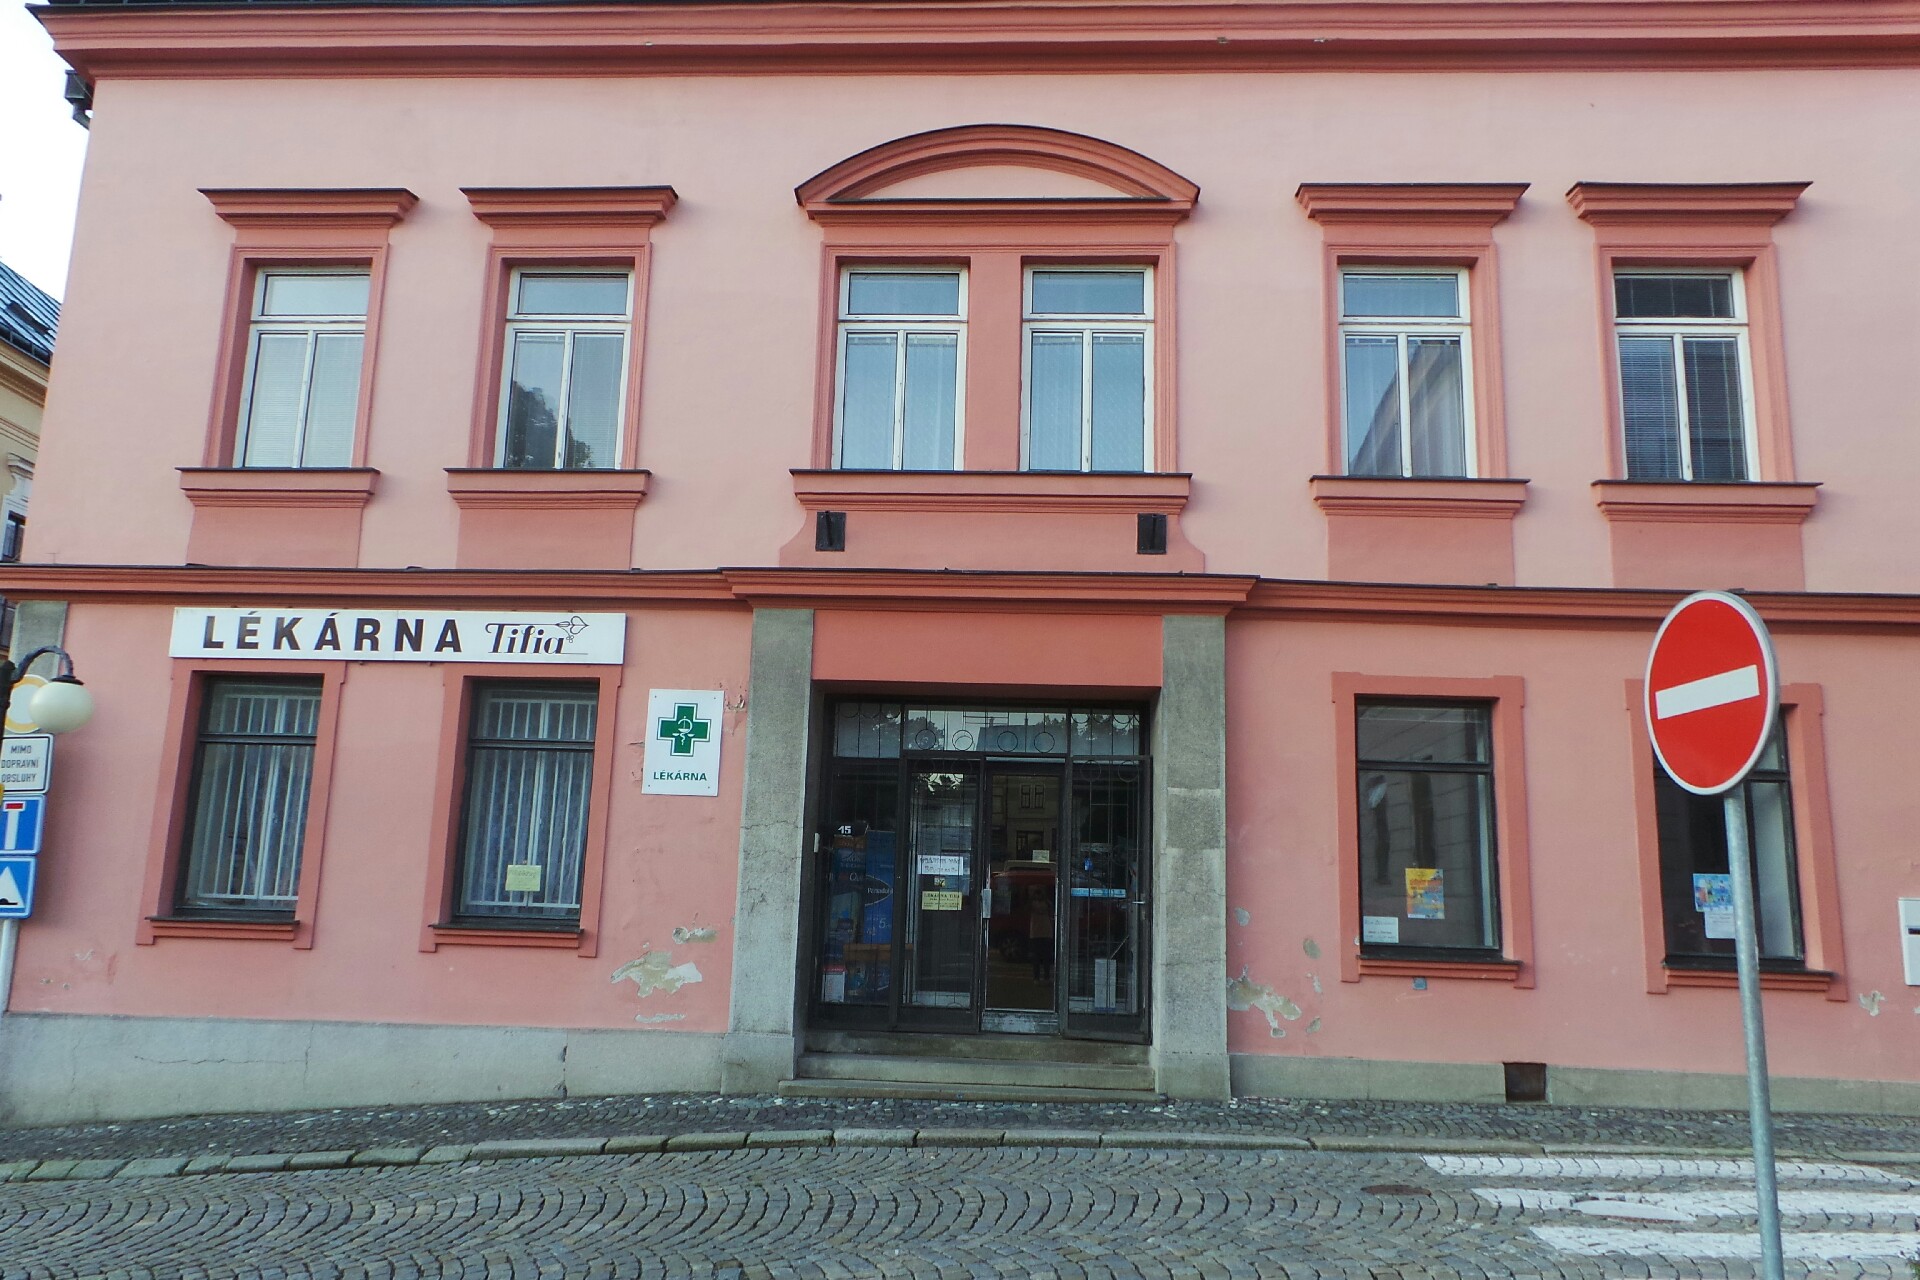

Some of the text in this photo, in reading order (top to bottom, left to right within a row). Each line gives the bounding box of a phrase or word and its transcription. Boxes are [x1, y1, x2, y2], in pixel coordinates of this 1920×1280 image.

[202, 610, 462, 653] LÉKÁRNA
[10, 745, 32, 754] MIMO
[1, 757, 39, 768] DOPRAVNÍ
[1, 773, 36, 783] OBSLUHY
[653, 769, 708, 781] LÉKÁRNA
[838, 825, 852, 834] 15
